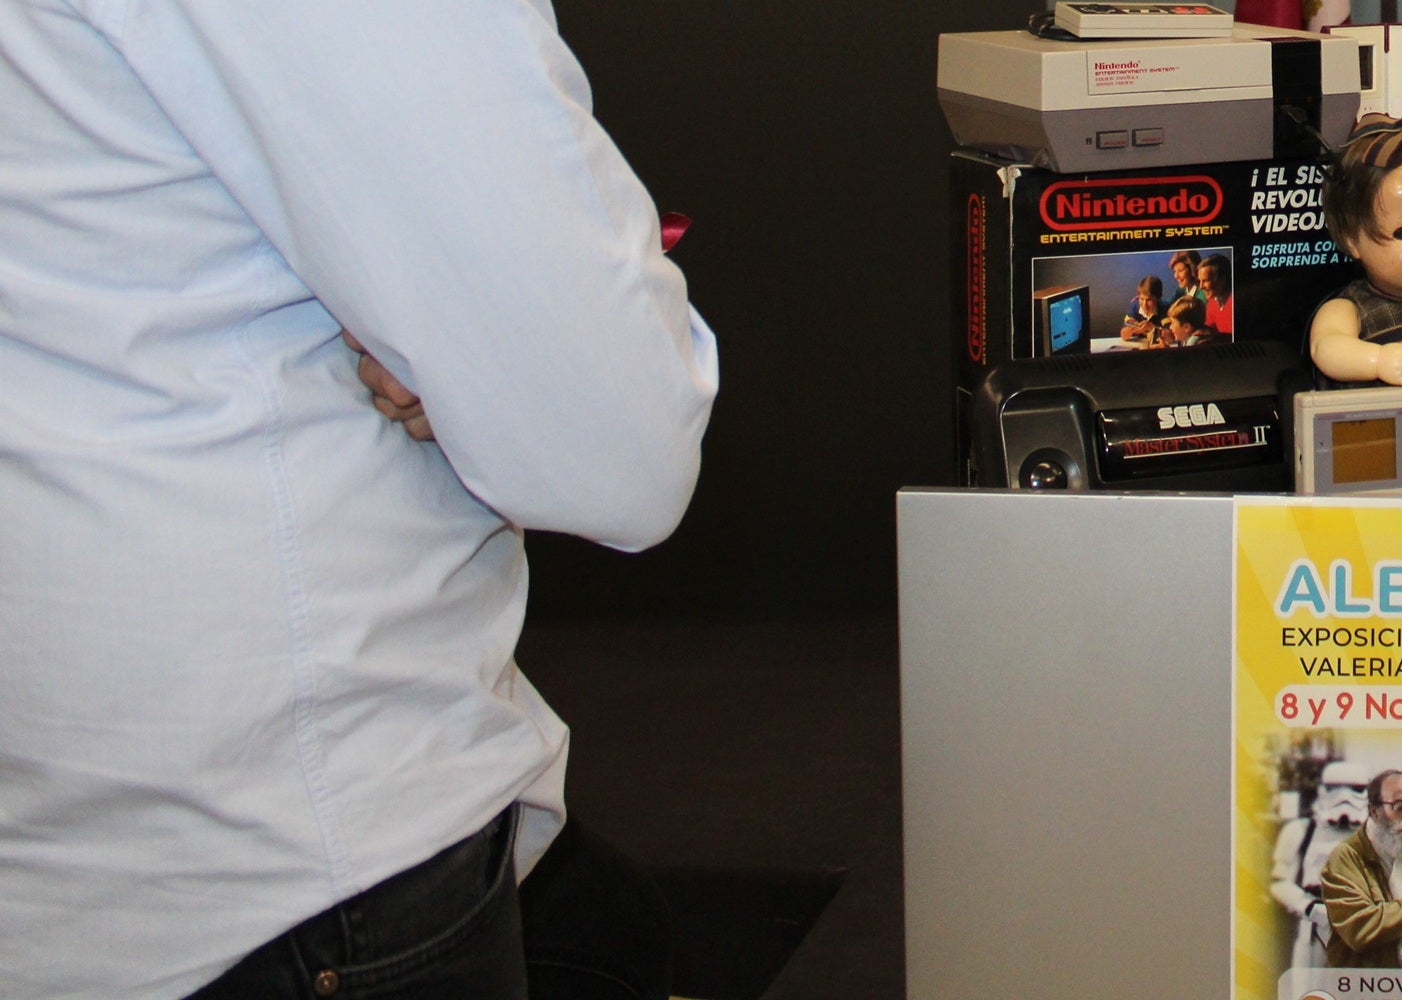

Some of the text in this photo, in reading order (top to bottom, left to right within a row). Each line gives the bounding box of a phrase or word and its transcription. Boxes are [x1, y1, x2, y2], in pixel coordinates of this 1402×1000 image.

[1094, 60, 1139, 71] Nintendo
[1265, 167, 1288, 187] EL
[1056, 188, 1210, 220] Nintendo
[1040, 225, 1224, 244] ENTERTAINMENT SYSTEM
[1251, 242, 1310, 257] DISFRUTA
[1251, 253, 1327, 269] SORPRENDE
[1330, 252, 1339, 264] A
[1157, 402, 1226, 430] SEGA
[1123, 437, 1184, 457] Master
[1186, 431, 1250, 456] System
[1280, 693, 1298, 720] 8
[1308, 699, 1327, 725] y
[1337, 693, 1353, 720] 9
[1338, 976, 1351, 993] 8
